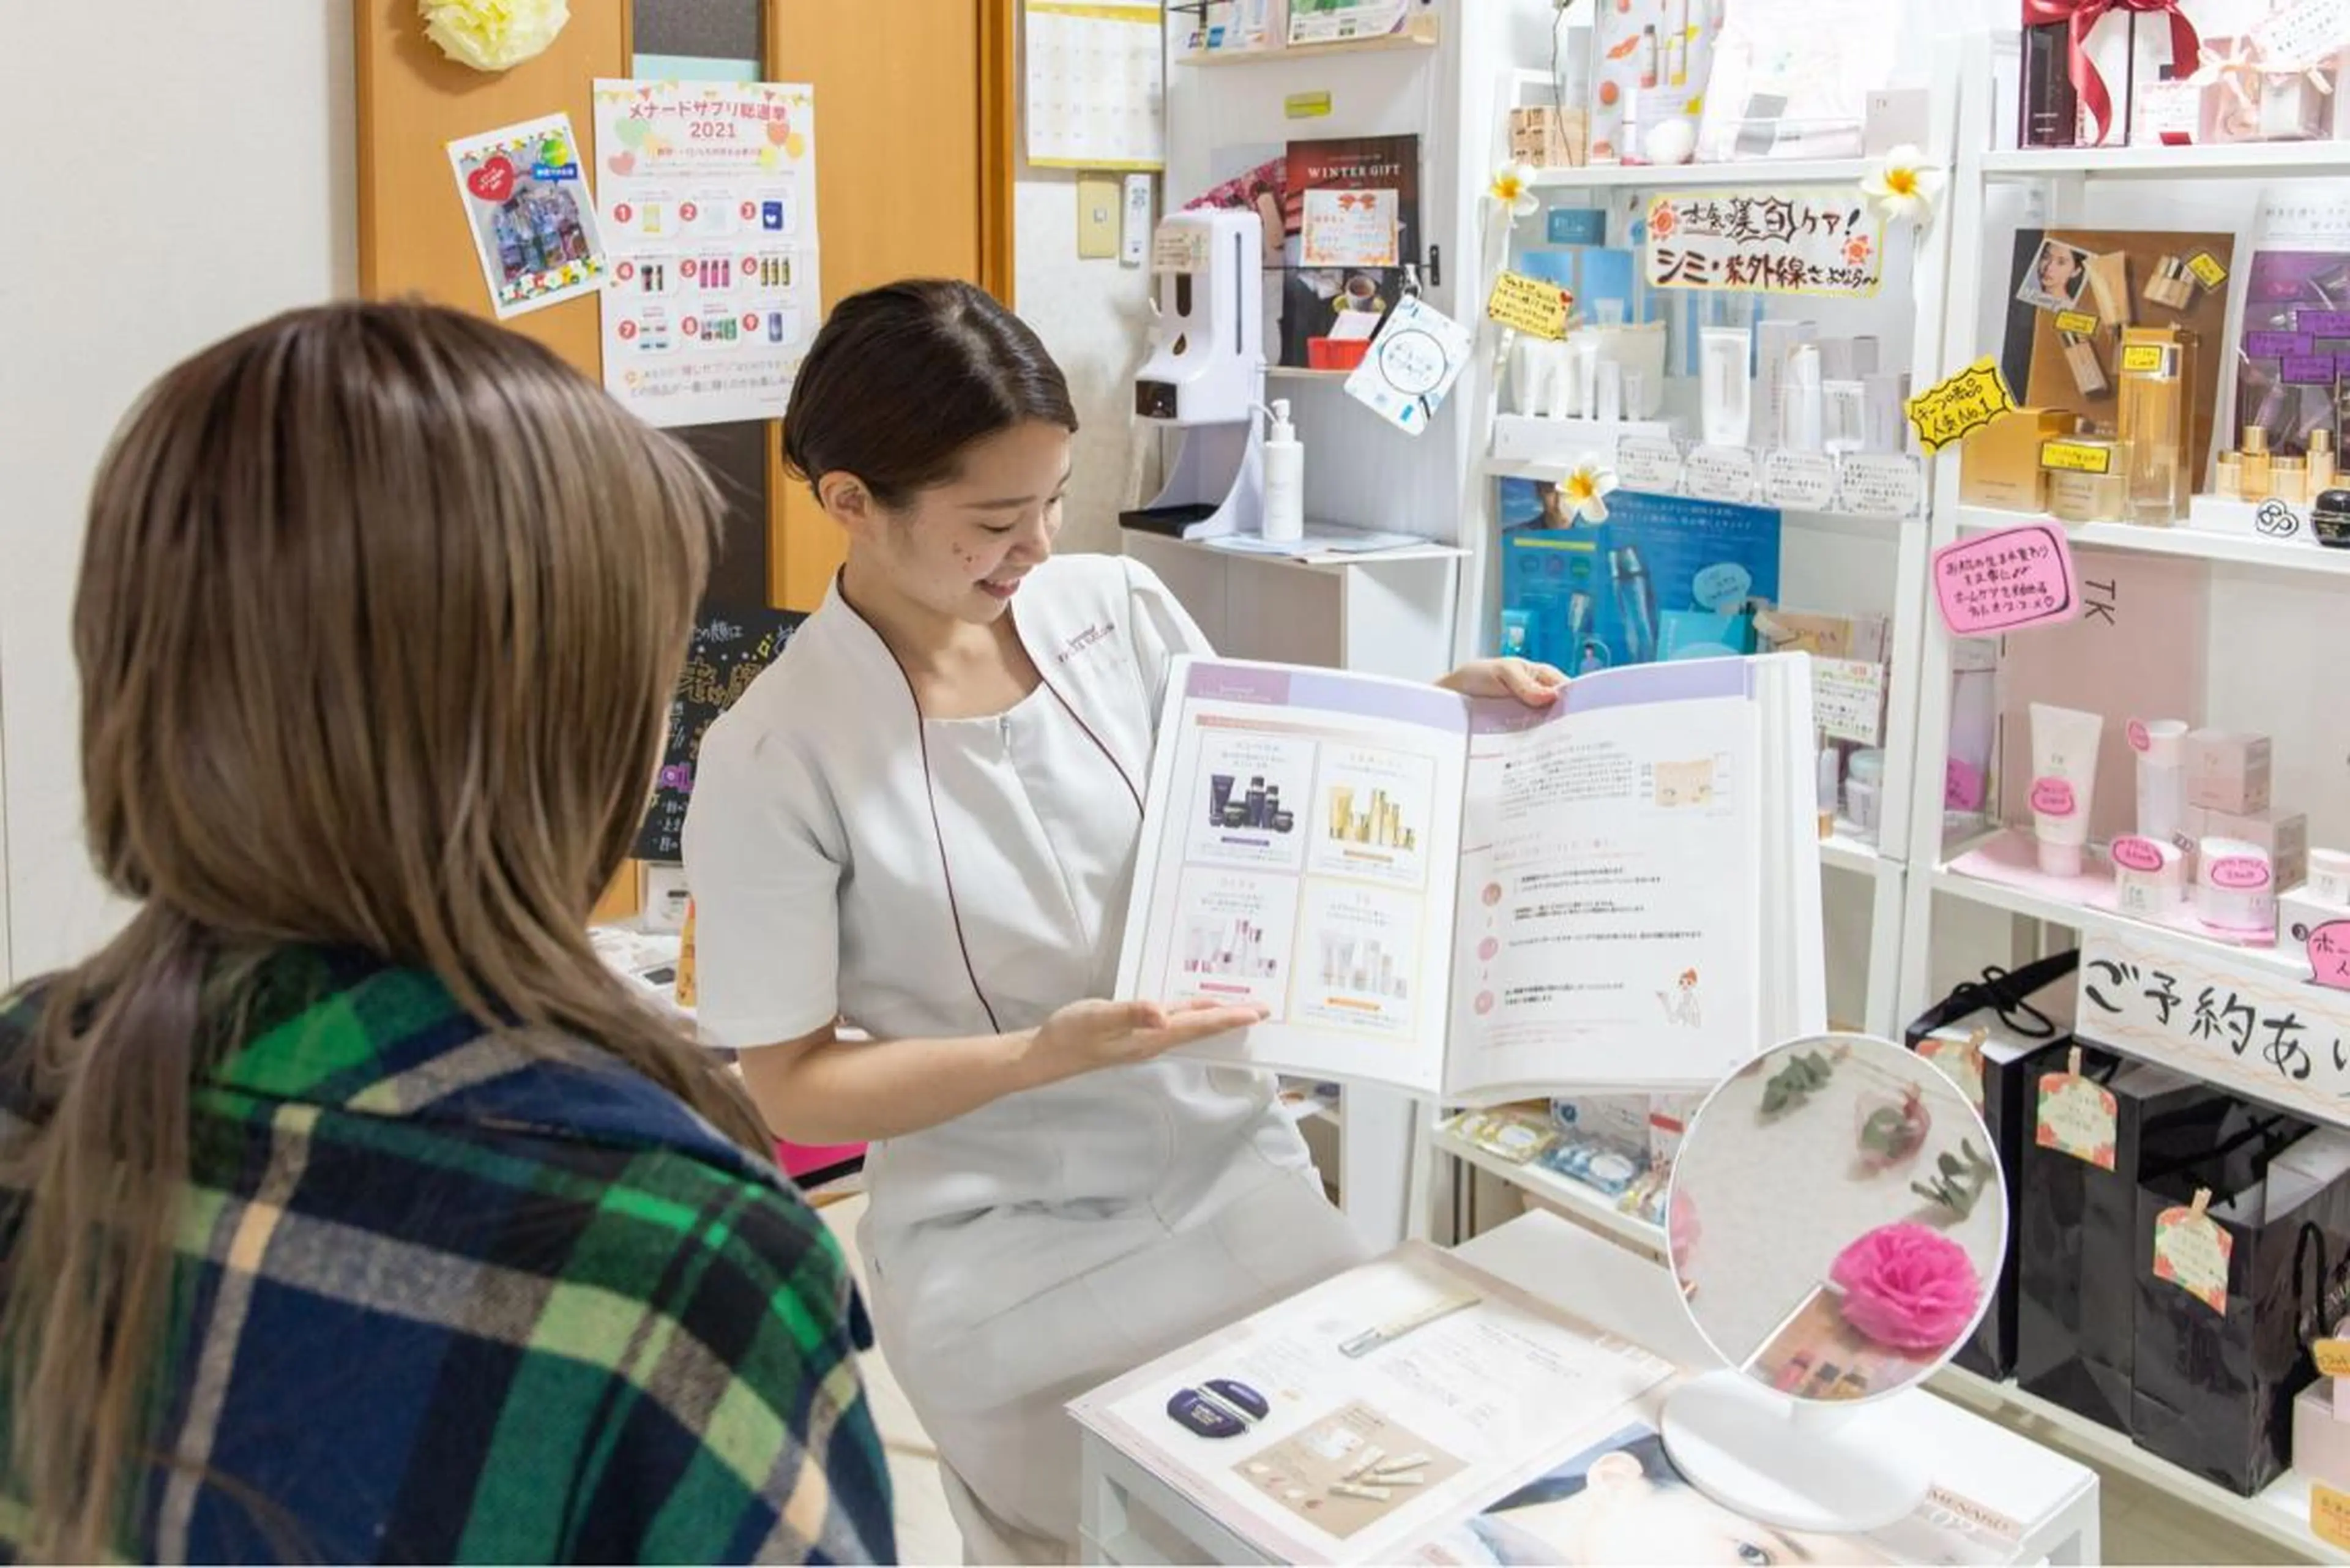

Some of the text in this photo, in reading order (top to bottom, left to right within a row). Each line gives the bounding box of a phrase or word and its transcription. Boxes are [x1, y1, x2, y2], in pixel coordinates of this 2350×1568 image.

[689, 122, 737, 139] 2021
[1308, 164, 1401, 178] WINTER GIFT
[2084, 578, 2116, 626] TK
